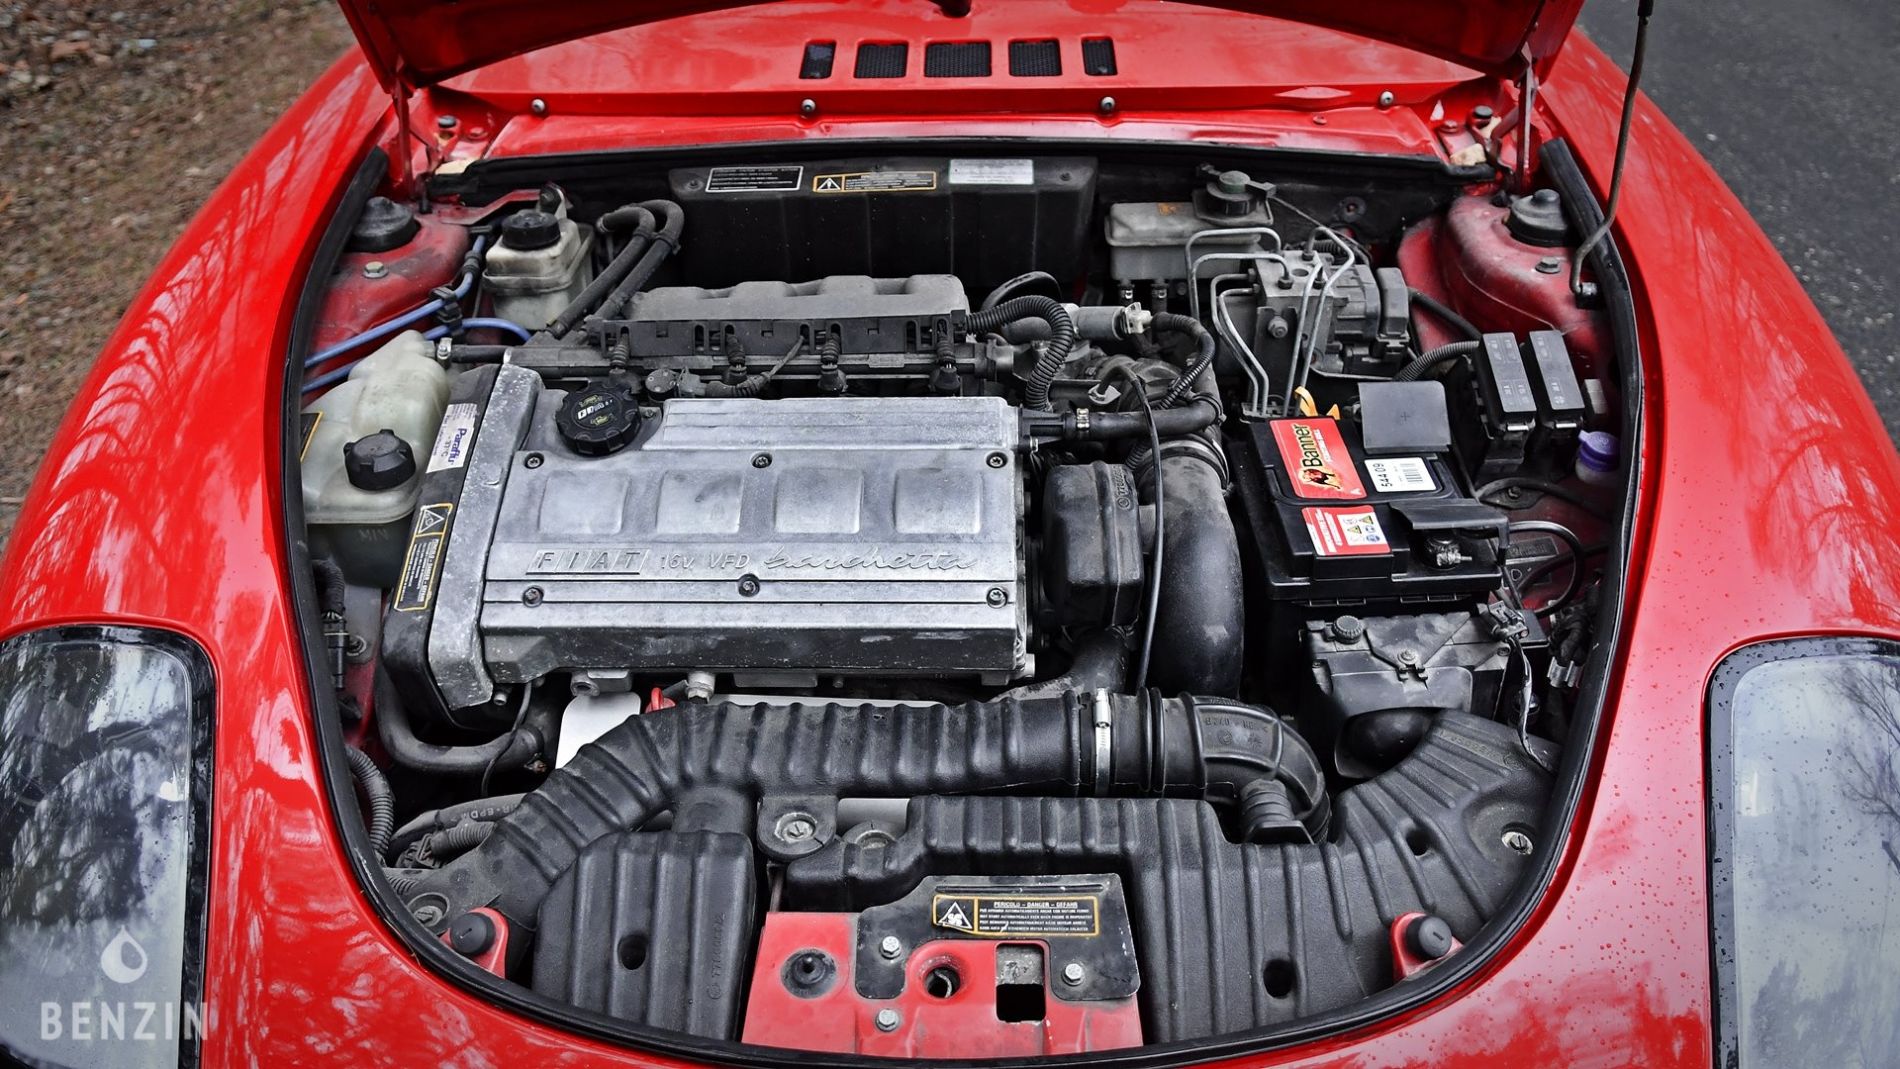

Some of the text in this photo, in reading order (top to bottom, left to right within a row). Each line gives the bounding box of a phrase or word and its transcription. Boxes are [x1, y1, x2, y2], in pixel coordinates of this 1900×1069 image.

[448, 428, 467, 463] Paraflu
[1293, 424, 1322, 467] Banner
[534, 550, 644, 571] FIAT
[709, 552, 750, 570] VFD
[764, 546, 978, 571] barchetta
